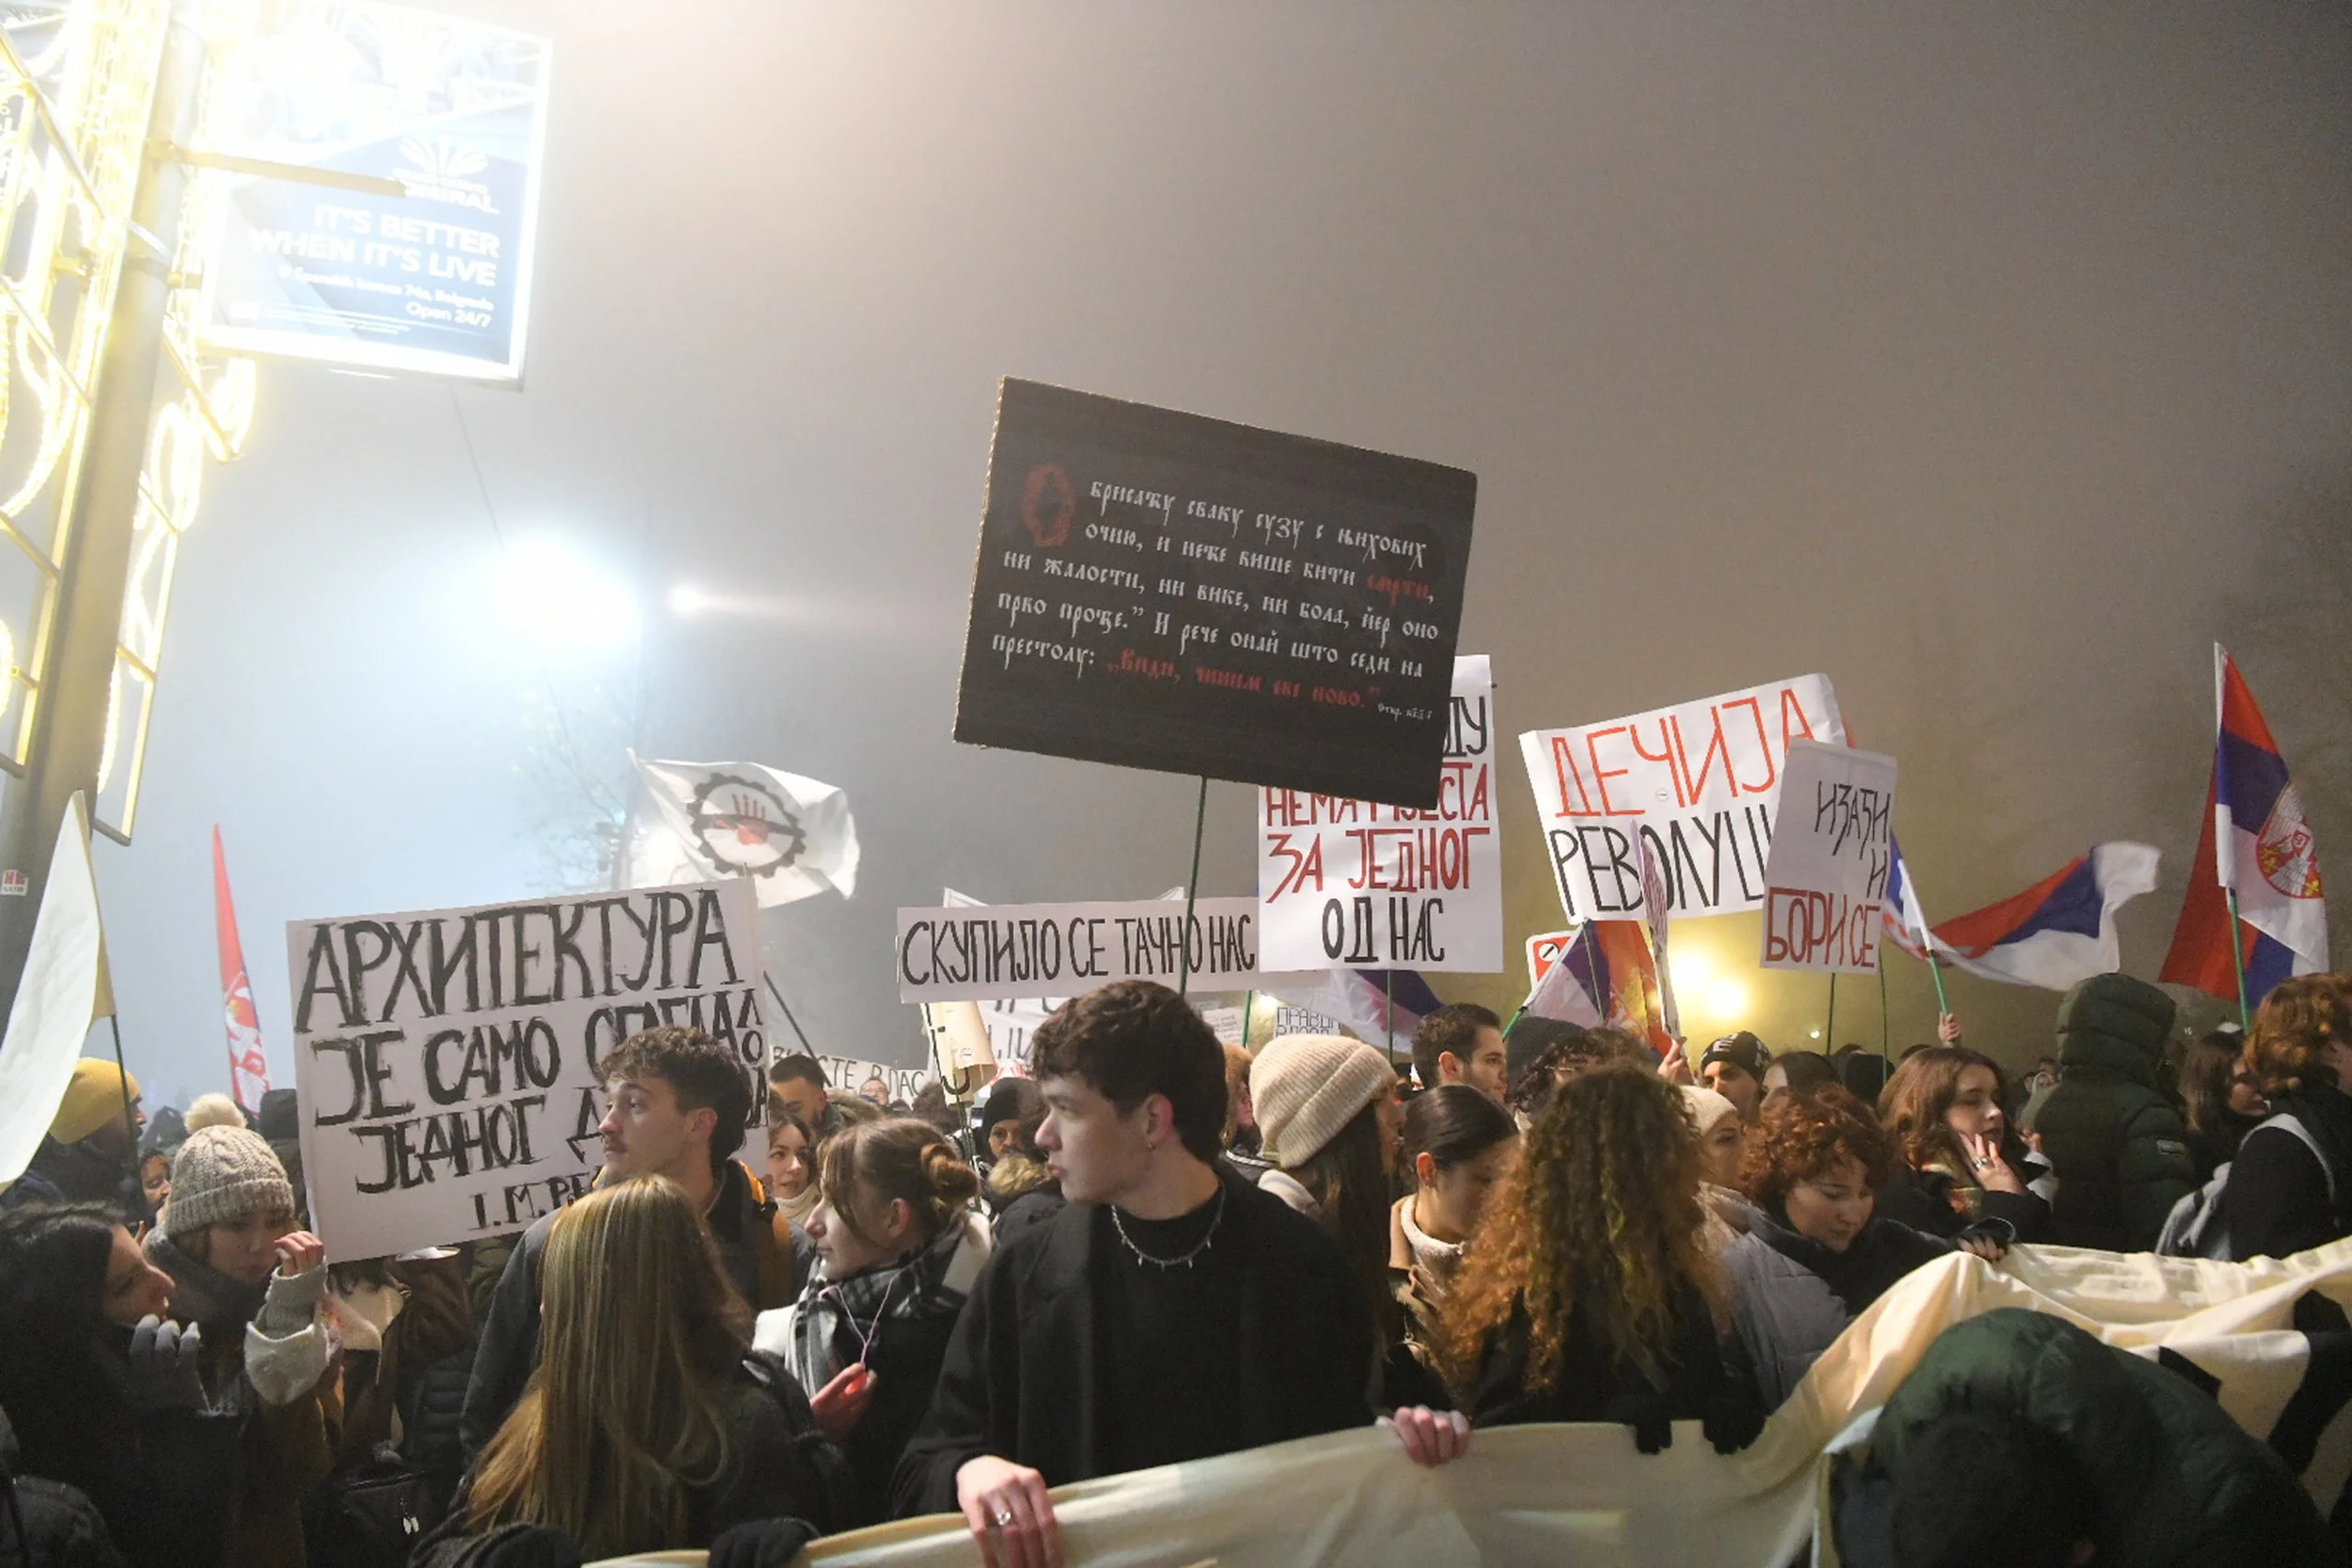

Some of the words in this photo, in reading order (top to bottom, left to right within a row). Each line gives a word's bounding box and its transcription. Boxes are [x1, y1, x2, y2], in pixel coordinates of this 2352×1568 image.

[250, 230, 356, 263] WHEN
[363, 242, 422, 273] IT'S
[429, 253, 497, 288] LIVE
[316, 205, 372, 235] IT'S
[380, 213, 501, 257] BETTER
[406, 301, 452, 321] Open
[1551, 688, 1817, 818] ДЕЧИЈА
[1266, 832, 1322, 904] ЗА
[1345, 827, 1493, 892] ЈЕДНОГ
[295, 888, 745, 1034] АРХИТЕКТУРА
[900, 916, 1062, 987] СКУПИЛО
[1067, 916, 1110, 976] СЕ
[1114, 913, 1204, 976] ТАЧНО
[1208, 912, 1256, 975] НАС
[1321, 897, 1379, 963] ОД
[1390, 897, 1446, 962] НАС
[310, 1028, 416, 1128] ЈЕ
[421, 1015, 562, 1106] САМО
